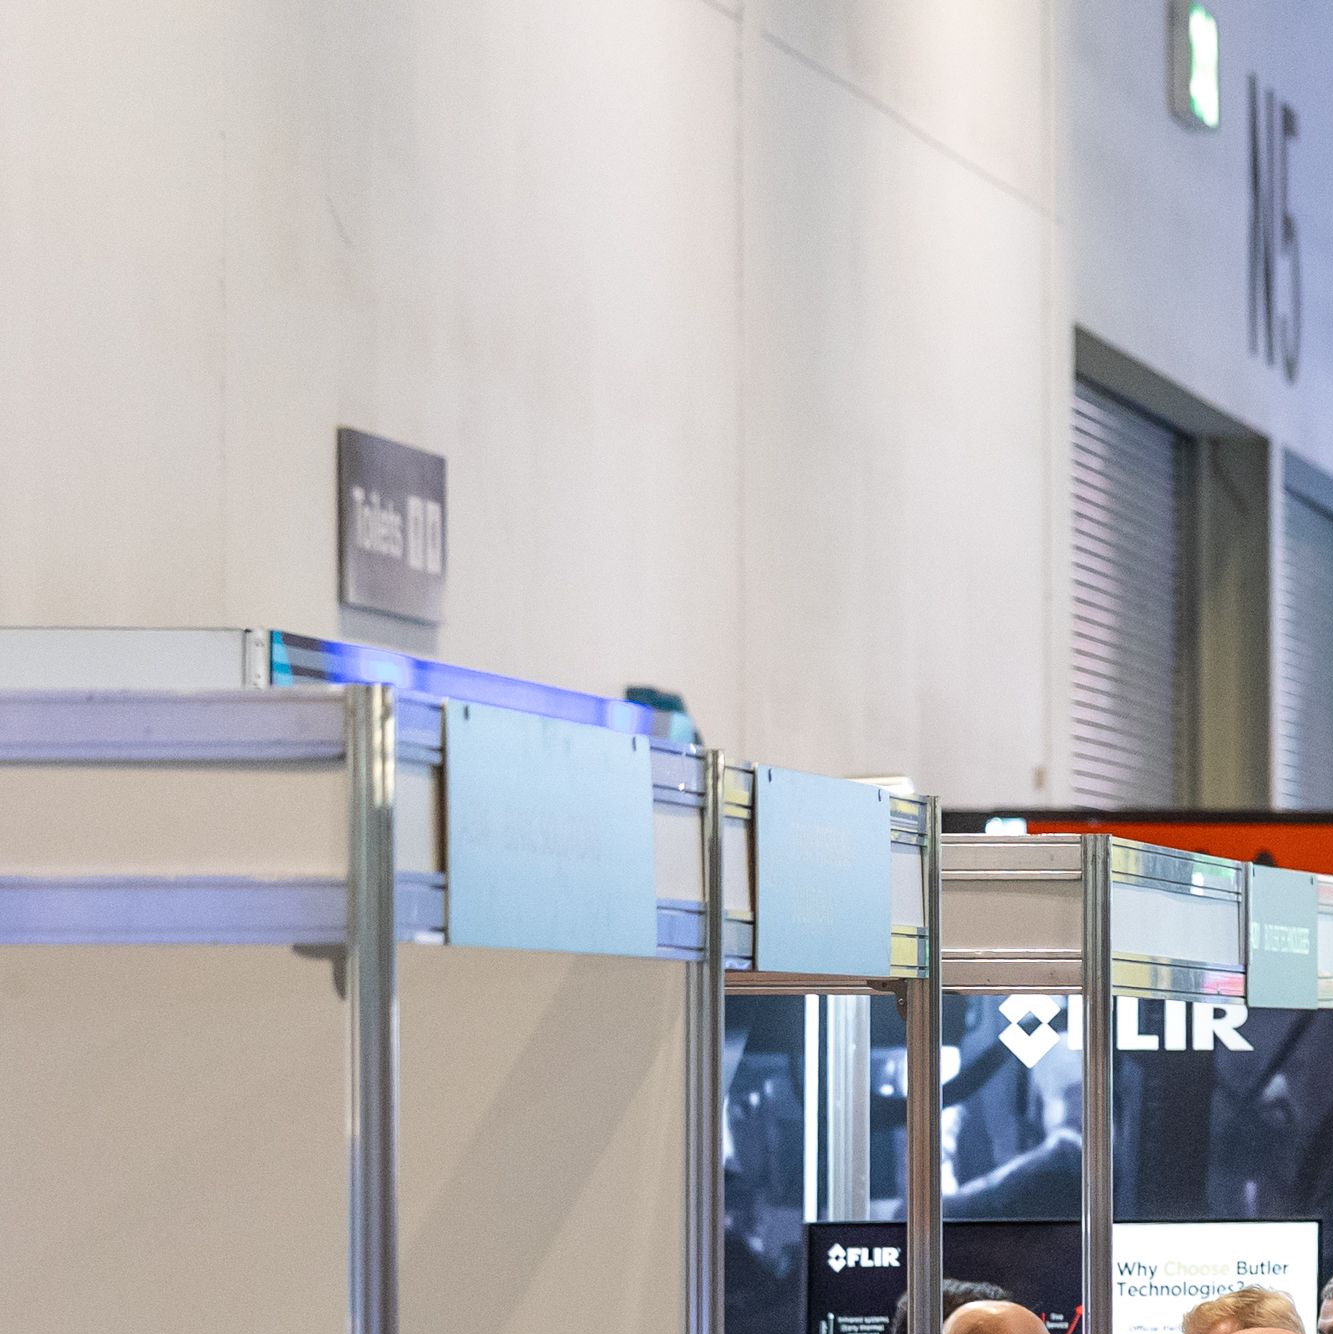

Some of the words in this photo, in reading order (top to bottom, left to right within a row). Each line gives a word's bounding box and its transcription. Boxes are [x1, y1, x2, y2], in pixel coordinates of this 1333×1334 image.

[847, 1247, 900, 1267] FLIR
[1117, 1262, 1157, 1279] Why
[1164, 1261, 1230, 1276] Choose
[1236, 1261, 1288, 1275] Butler
